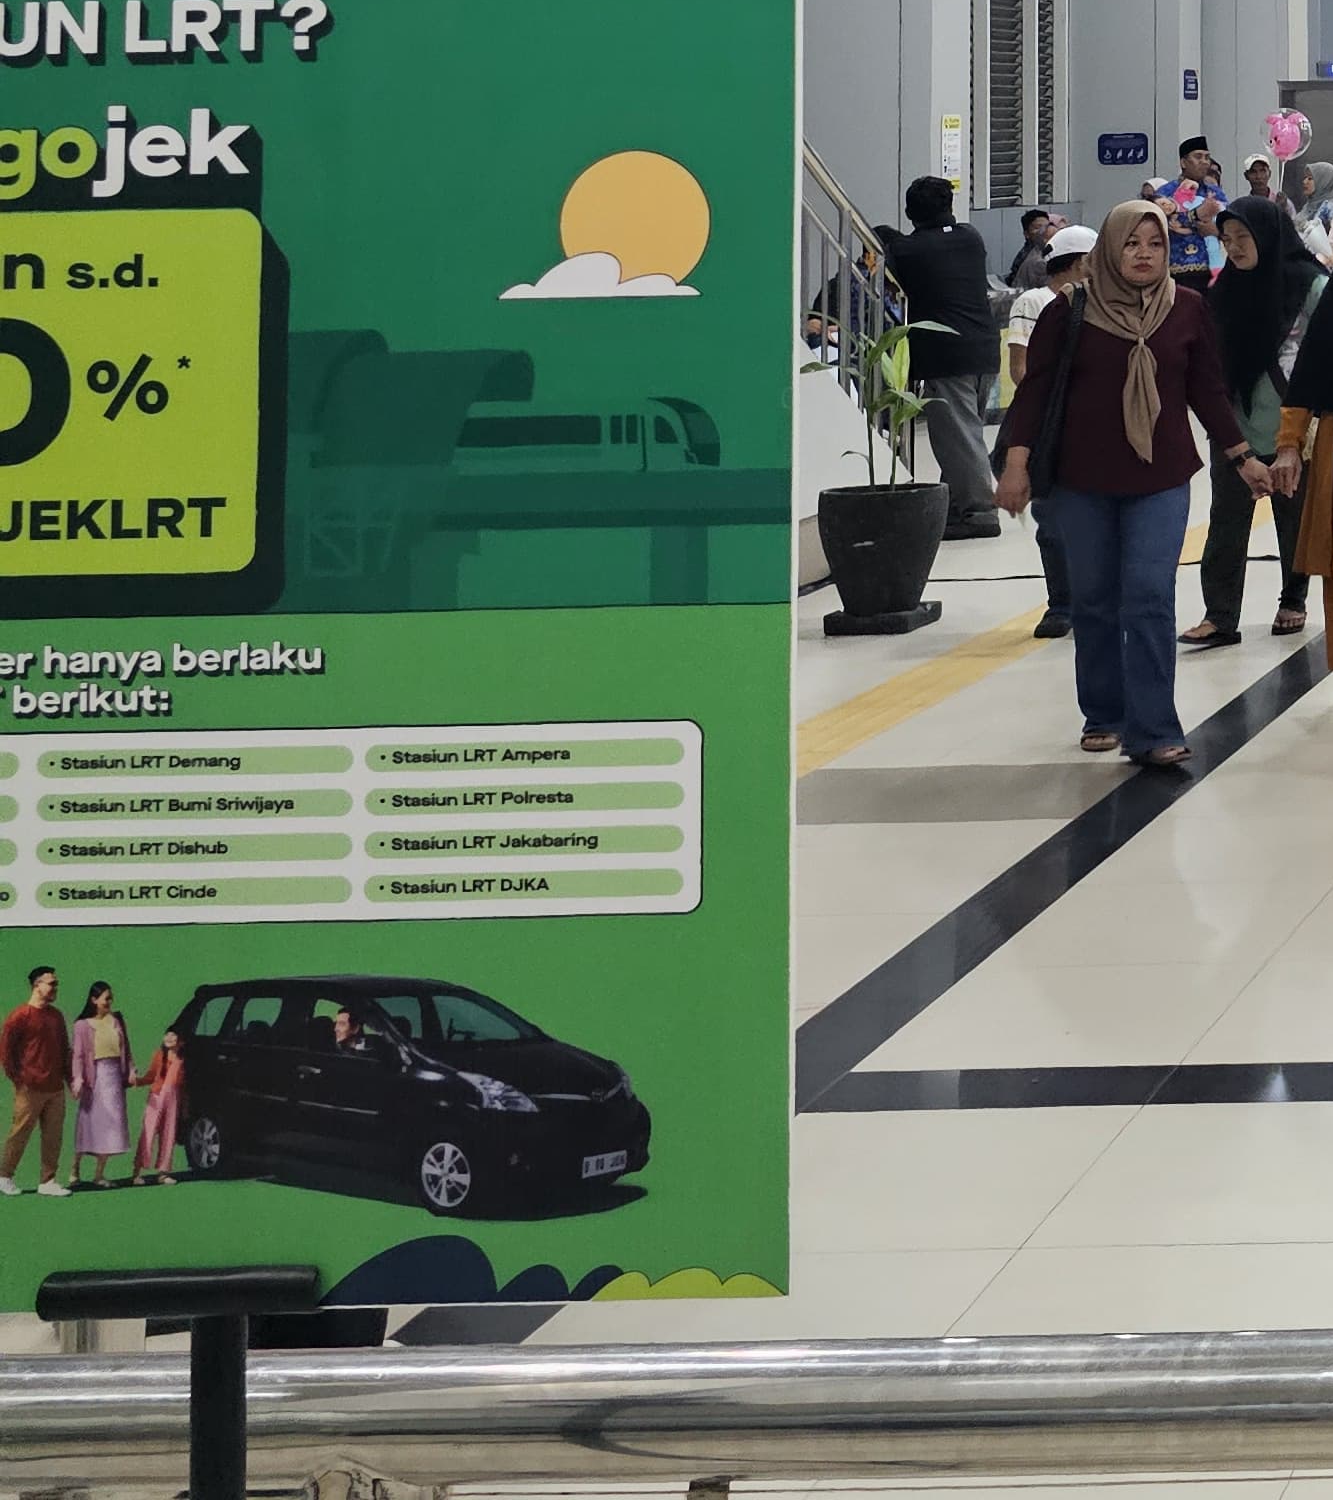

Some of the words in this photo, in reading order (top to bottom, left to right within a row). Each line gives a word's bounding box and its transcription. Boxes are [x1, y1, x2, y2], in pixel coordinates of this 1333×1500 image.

[0, 0, 99, 58] UN
[0, 105, 250, 200] gojek
[66, 253, 159, 289] s.d.
[0, 497, 227, 542] JEKLRT
[44, 646, 162, 681] hanya
[172, 641, 322, 672] berlaku
[13, 683, 169, 714] berikut:
[60, 756, 126, 771] Stasiun
[131, 755, 164, 769] LRT
[168, 755, 241, 771] Demang
[392, 750, 458, 764] Stasiun
[463, 749, 498, 763] LRT
[501, 748, 571, 764] Ampera
[60, 800, 125, 814] Stasiun
[130, 799, 164, 813] LRT
[168, 797, 212, 812] Bumi
[216, 797, 294, 815] Sriwijaya
[391, 793, 458, 808] Stasiun
[463, 792, 497, 806] LRT
[501, 791, 574, 806] Polresta
[59, 843, 125, 858] Stasiun
[129, 842, 164, 856] LRT
[167, 841, 228, 856] Dishub
[391, 837, 457, 851] Stasiun
[462, 836, 496, 850] LRT
[500, 833, 599, 850] Jakabaring
[58, 887, 124, 901] Stasiun
[129, 886, 163, 900] LRT
[167, 885, 217, 899] Cinde
[391, 880, 457, 895] Stasiun
[462, 879, 496, 893] LRT
[500, 877, 549, 892] DJKA
